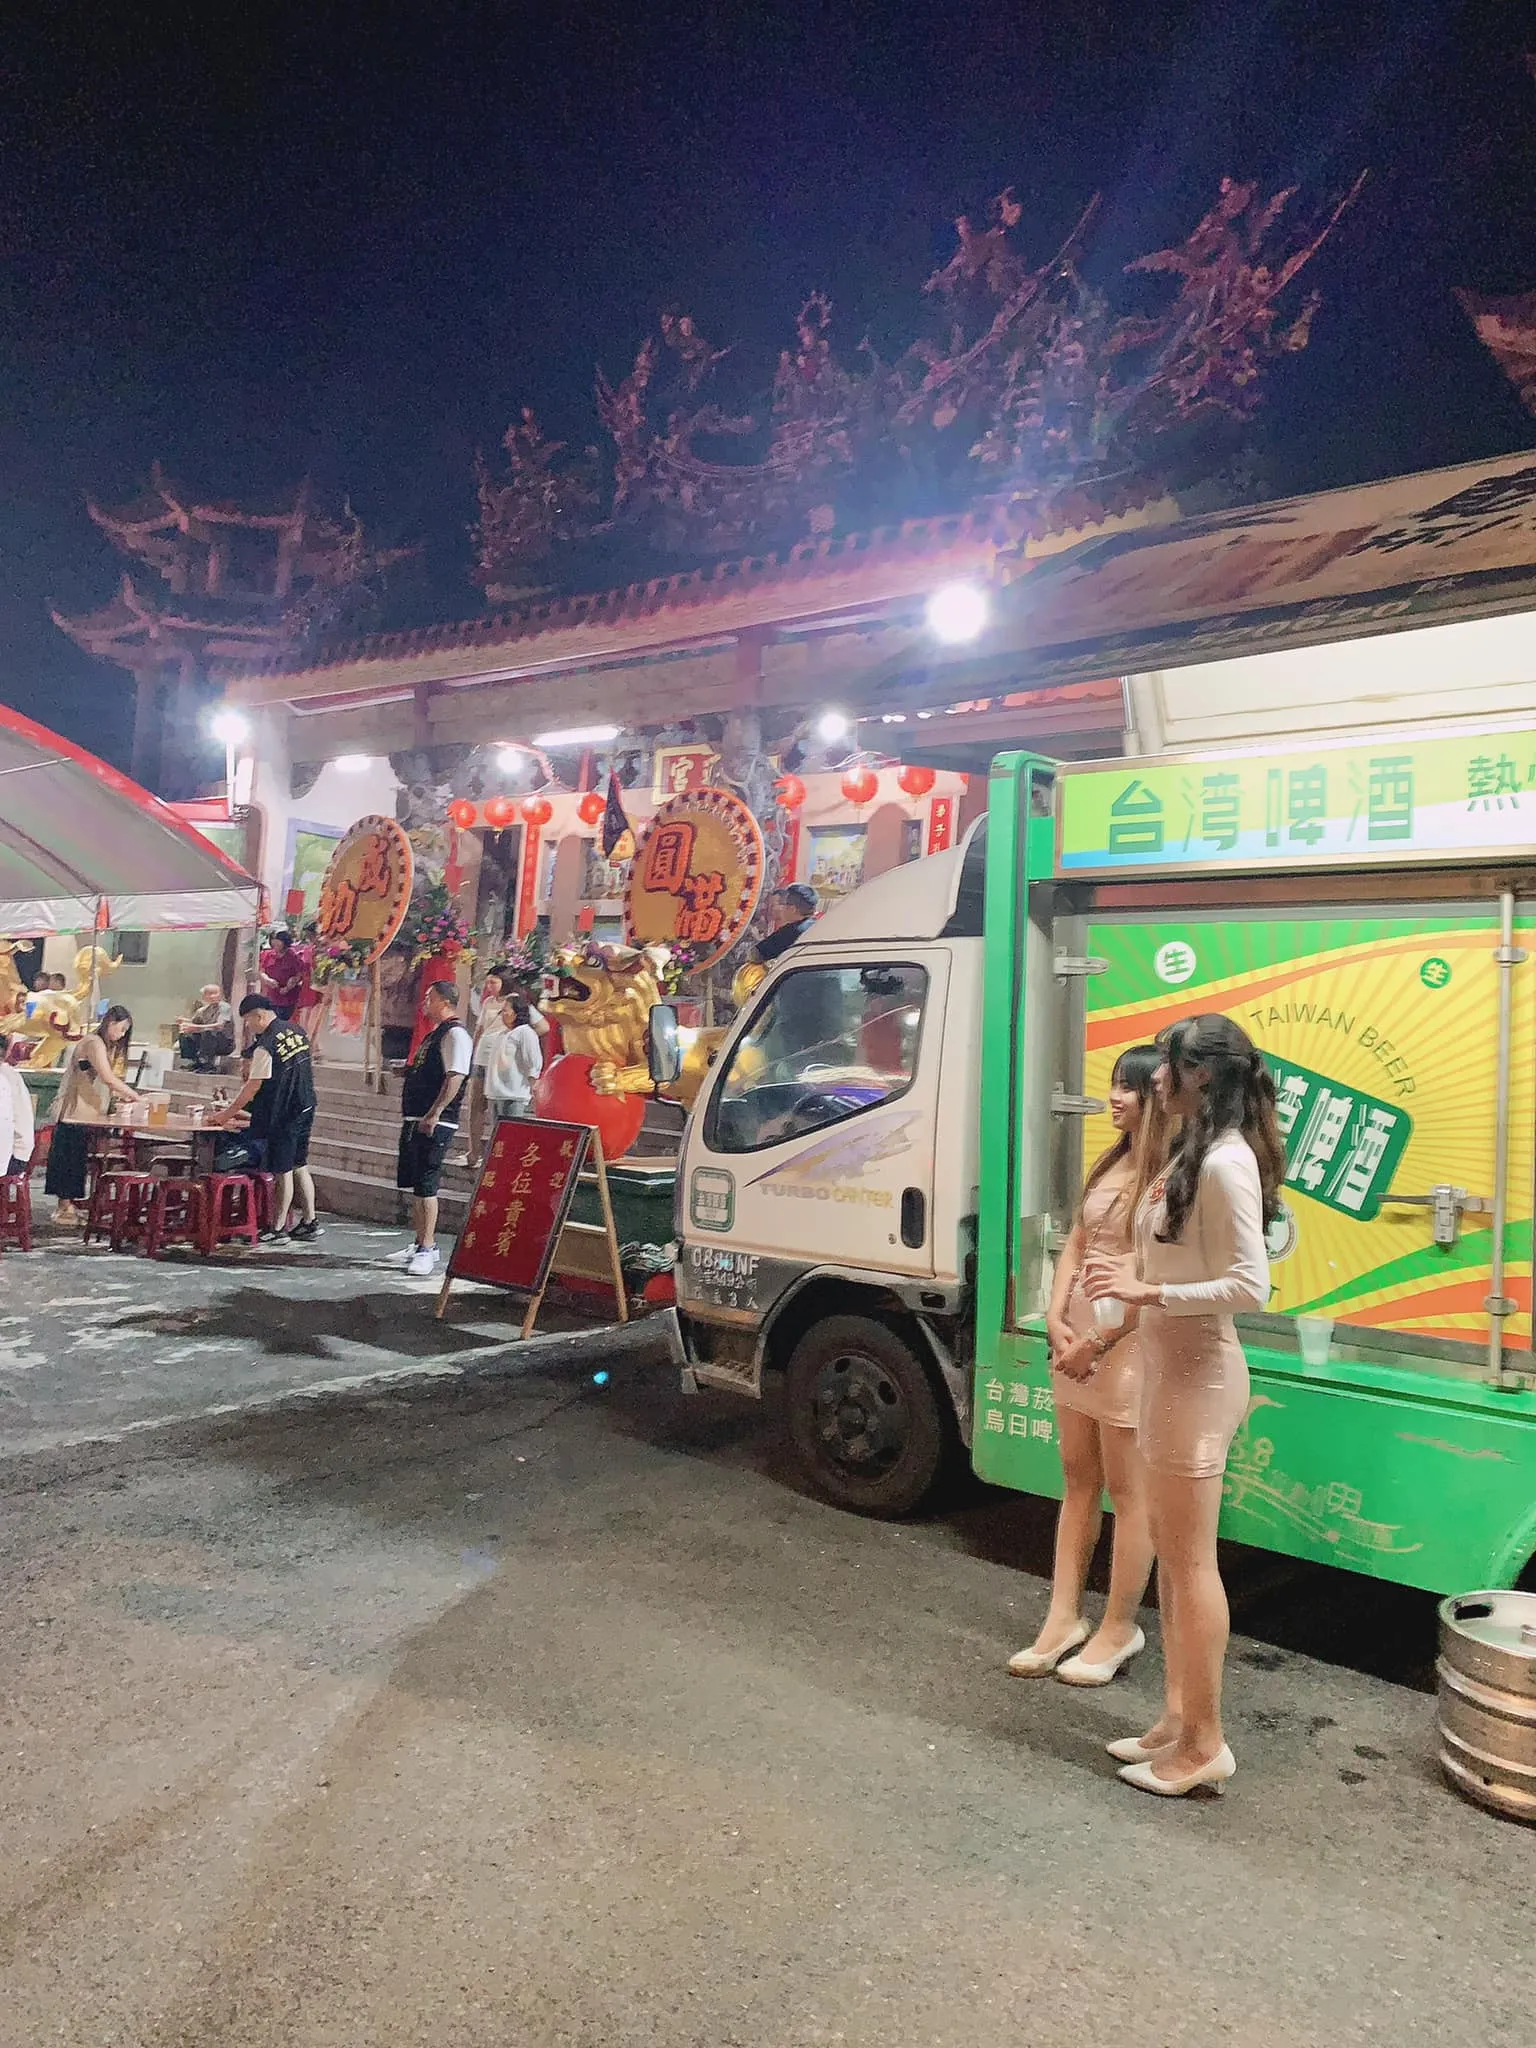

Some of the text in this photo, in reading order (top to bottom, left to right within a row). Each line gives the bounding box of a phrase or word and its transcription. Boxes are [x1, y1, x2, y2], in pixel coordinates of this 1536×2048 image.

[1467, 752, 1536, 812] 熱
[645, 821, 727, 943] 圓滿
[1163, 948, 1190, 977] 生
[1250, 1002, 1417, 1097] TAIWAN BEER
[492, 1142, 541, 1257] 各位貴賓
[759, 1182, 831, 1201] TURBO
[984, 1408, 1060, 1444] 烏日啤
